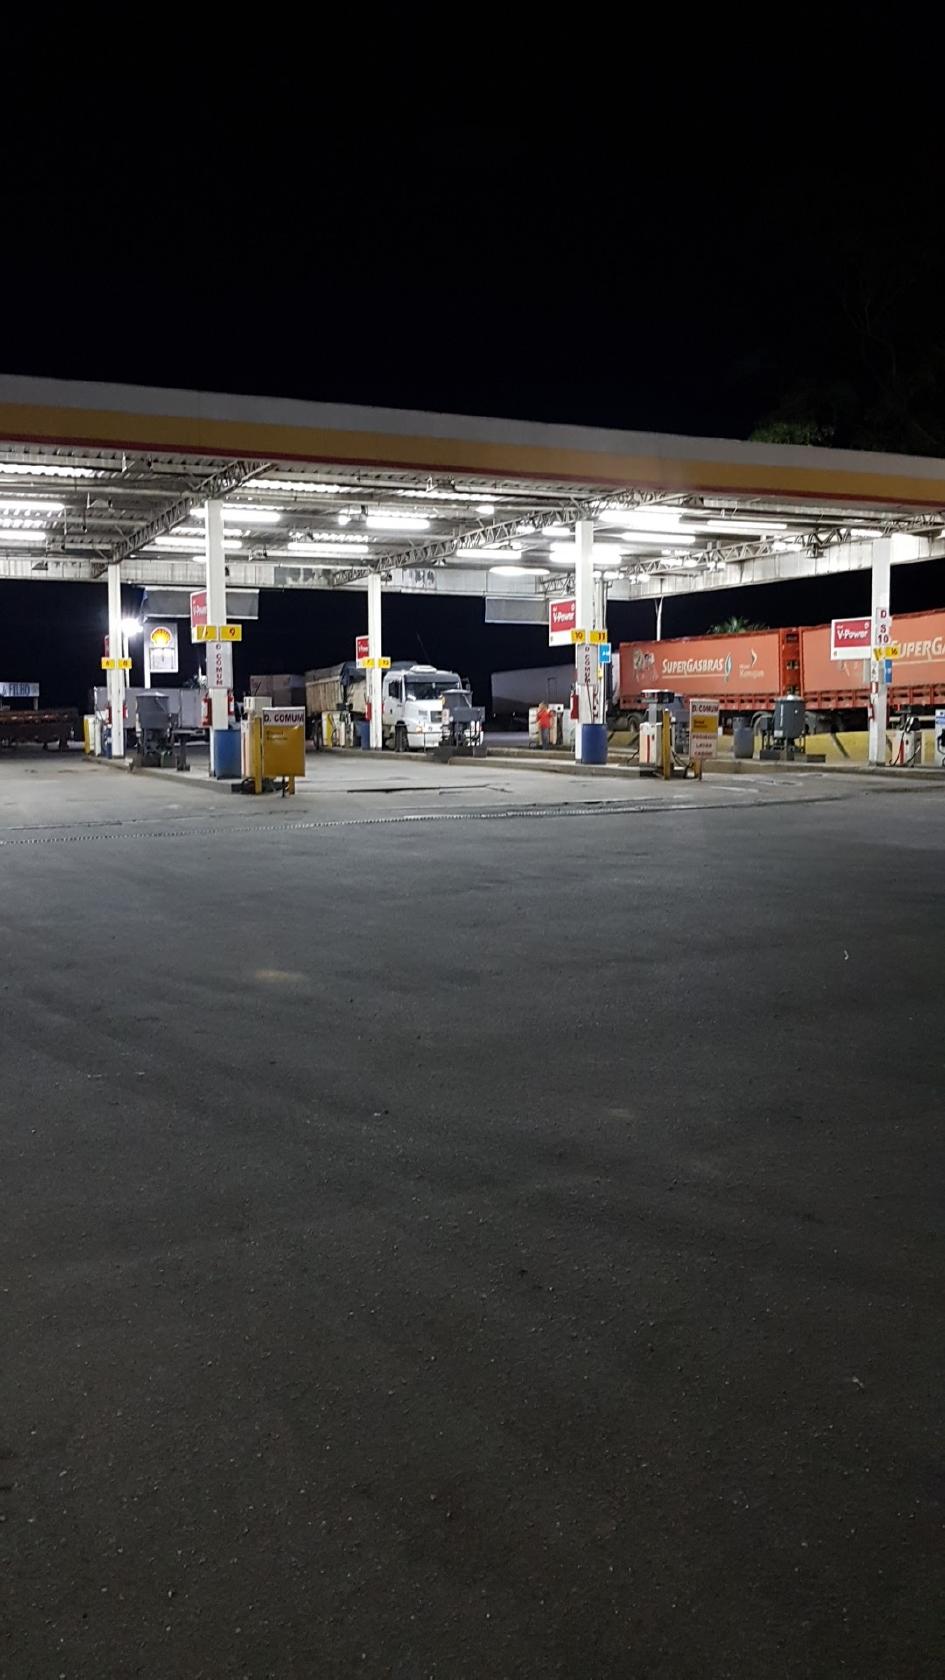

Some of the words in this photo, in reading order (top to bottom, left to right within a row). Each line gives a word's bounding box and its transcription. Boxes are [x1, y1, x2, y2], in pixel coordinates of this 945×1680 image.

[553, 612, 575, 623] V-Power
[880, 610, 887, 618] D
[598, 632, 606, 640] 11
[836, 629, 868, 640] V-Power
[878, 634, 889, 643] 10
[891, 637, 945, 660] UPERG
[264, 714, 271, 722] D.
[274, 713, 304, 722] COMUM
